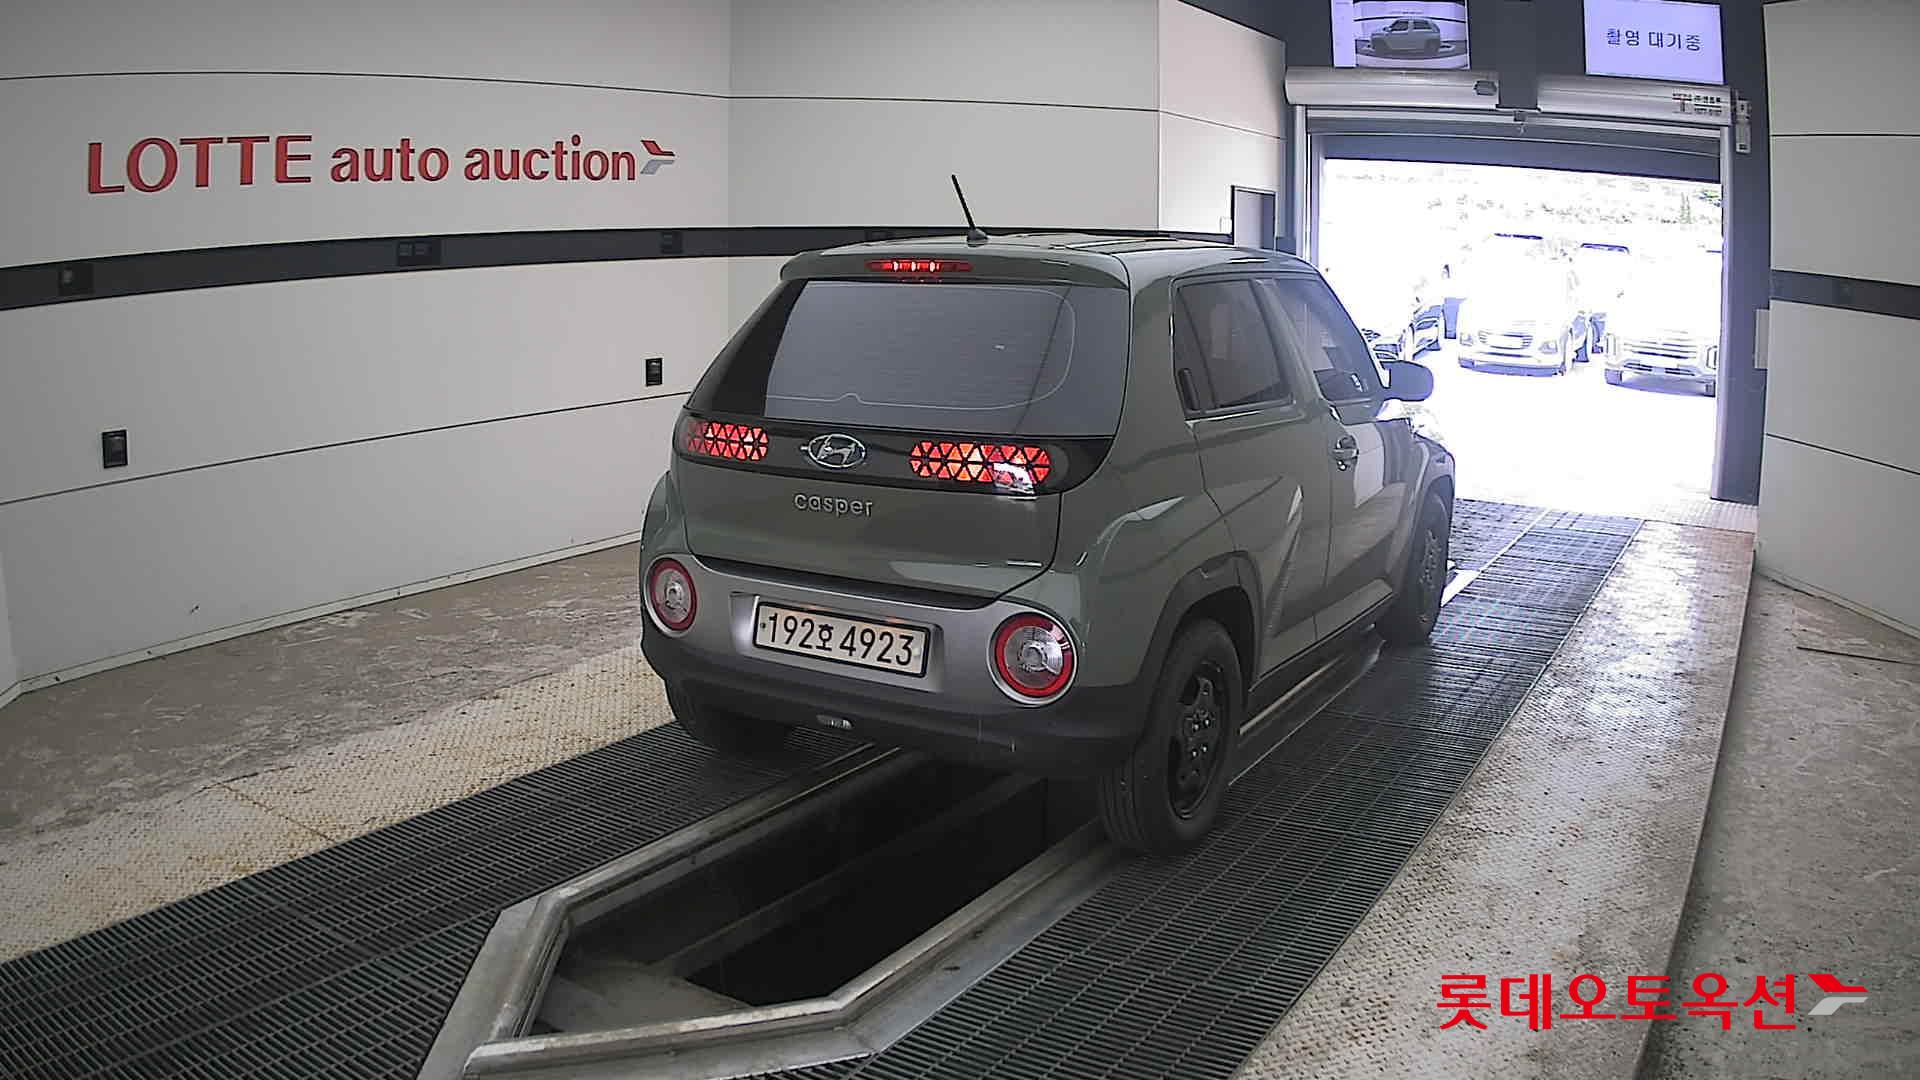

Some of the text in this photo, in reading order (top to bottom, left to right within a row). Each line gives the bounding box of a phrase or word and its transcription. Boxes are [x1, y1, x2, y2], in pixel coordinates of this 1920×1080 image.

[1648, 31, 1701, 52] 대기중
[87, 134, 636, 194] LOTTE auto auction
[794, 493, 873, 517] casper
[768, 612, 915, 666] 192호 4923
